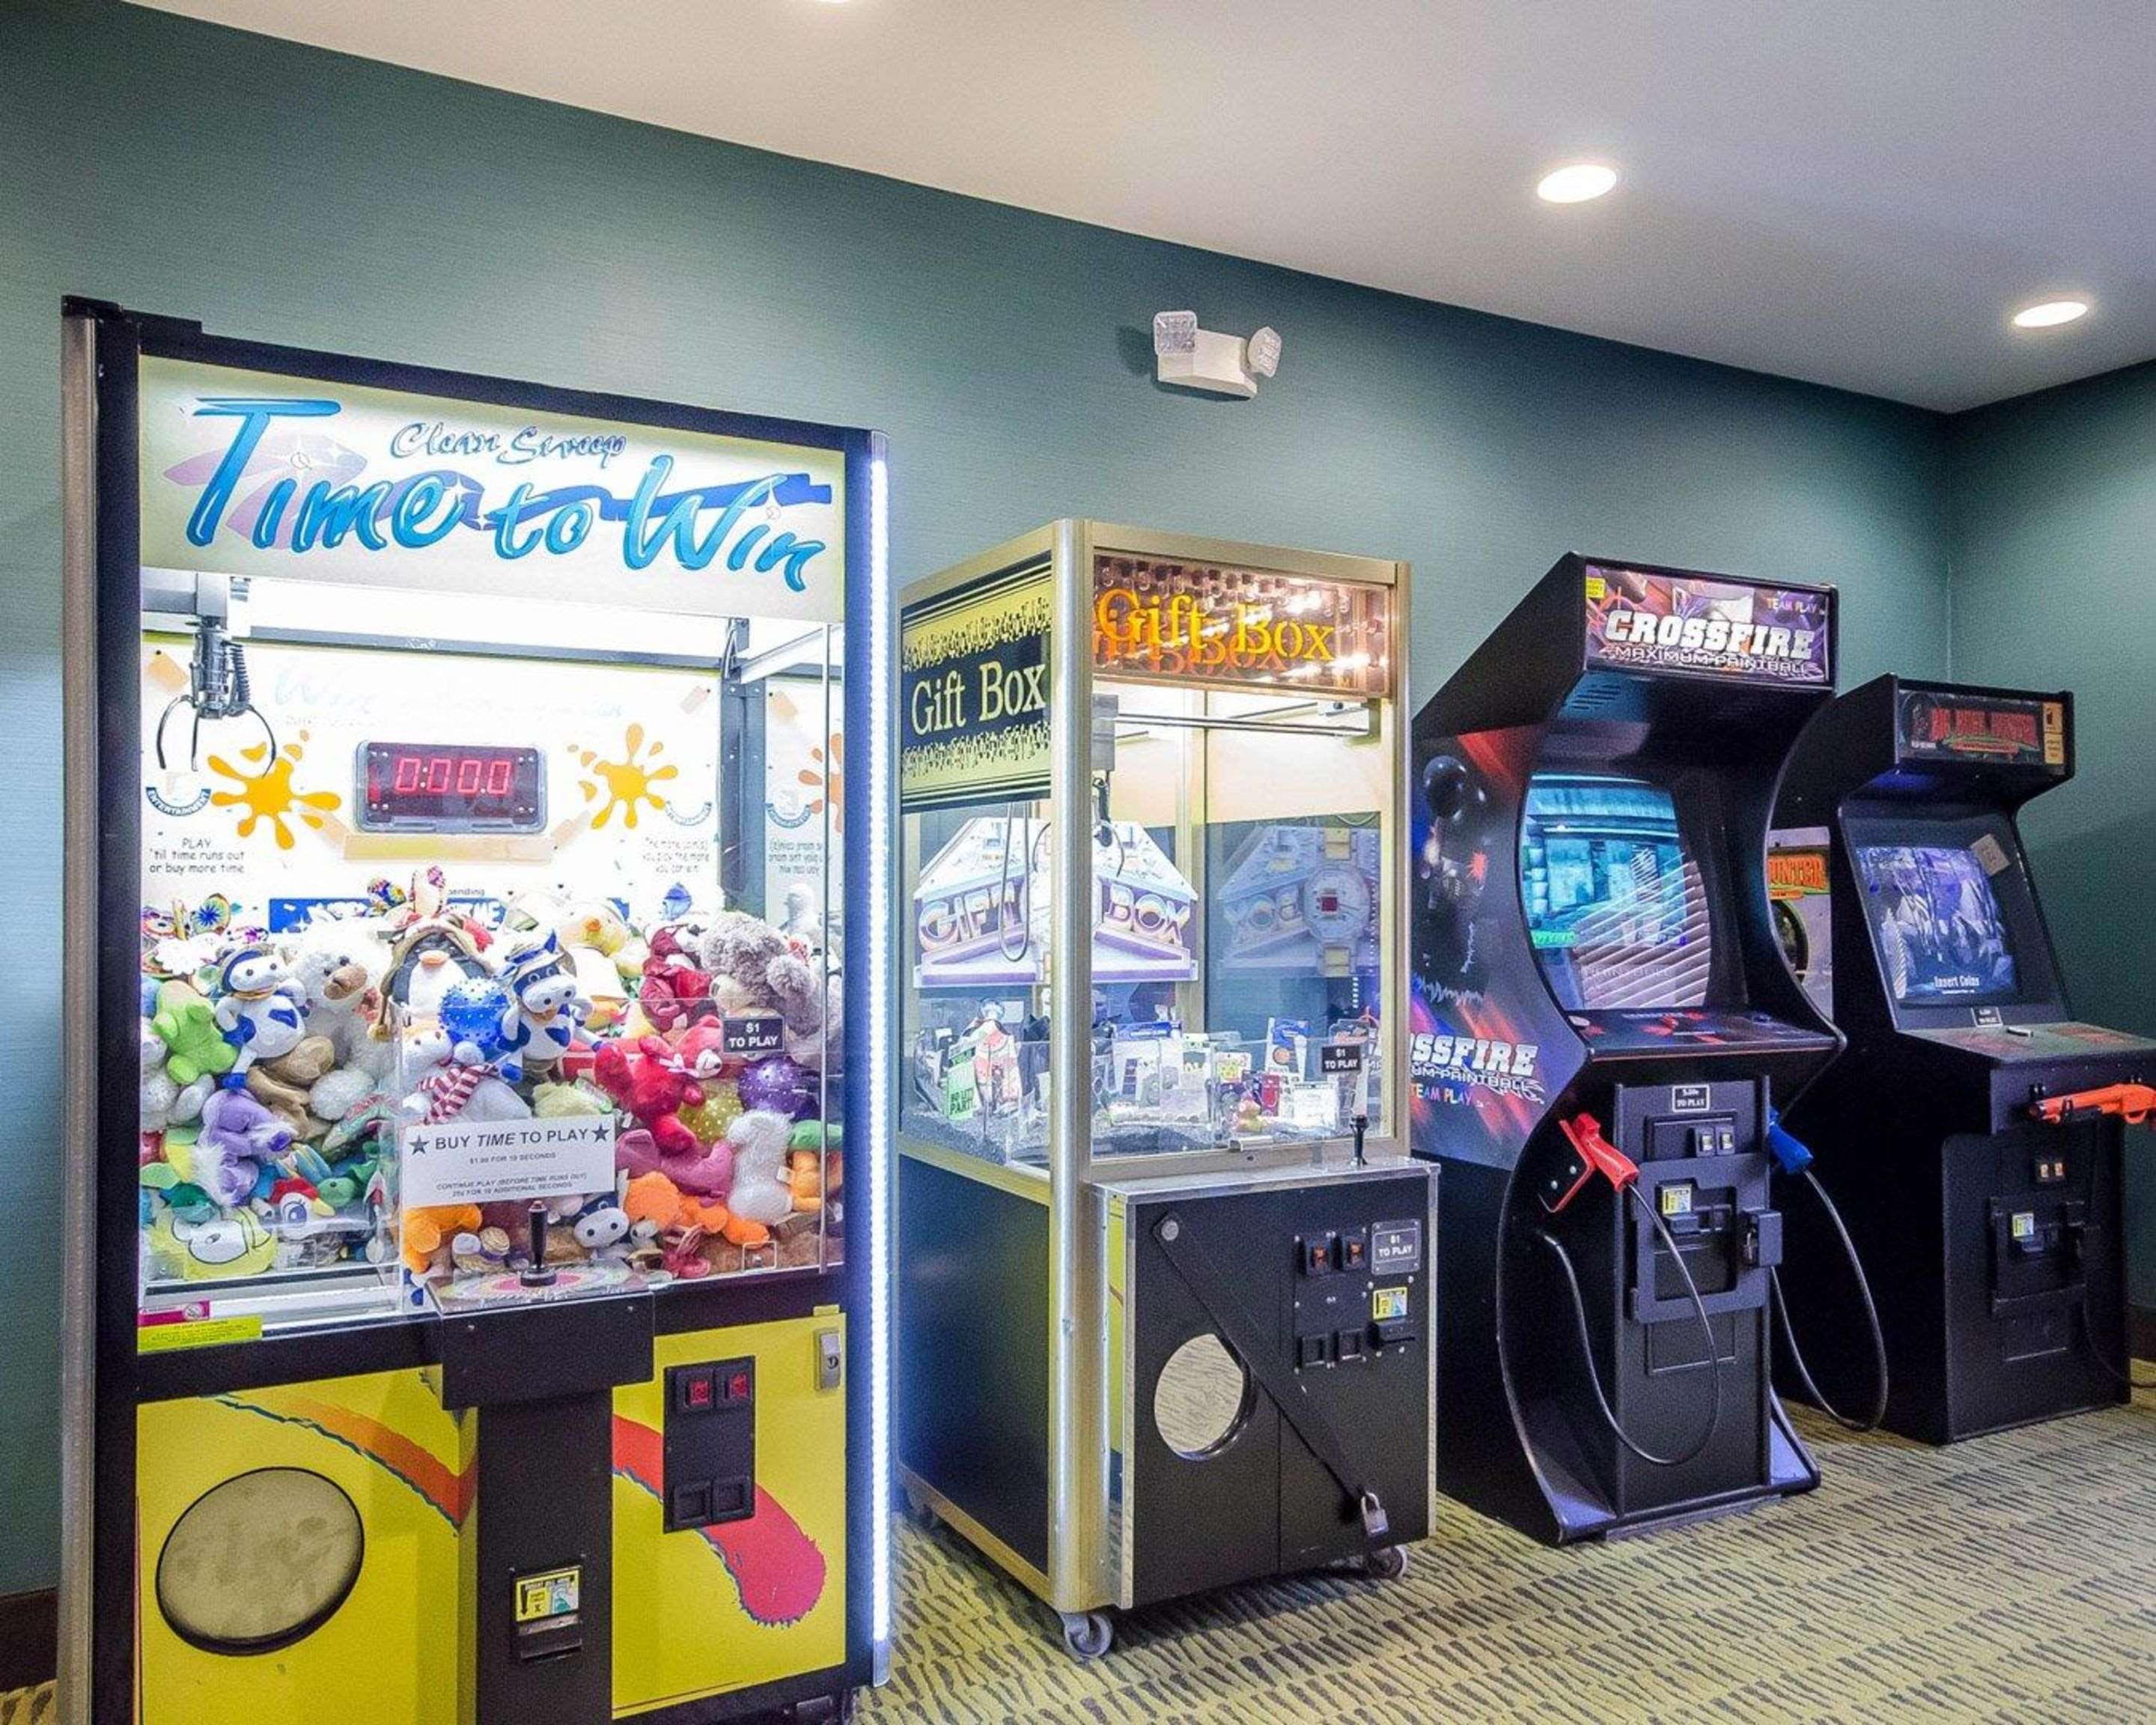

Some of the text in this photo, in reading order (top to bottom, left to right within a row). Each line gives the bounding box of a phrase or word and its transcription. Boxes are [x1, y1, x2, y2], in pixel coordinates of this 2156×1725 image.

[391, 422, 627, 469] Clean Sweep
[186, 398, 826, 594] Time to Win
[1766, 597, 1792, 612] TEAM
[1794, 600, 1818, 614] PLAY
[1099, 588, 1337, 662] Gift Box
[1605, 609, 1815, 660] CROSSFIRE
[911, 662, 1047, 736] Gift Box
[182, 838, 211, 850] PLAY
[172, 851, 196, 860] time
[200, 852, 224, 860] runs
[227, 851, 244, 860] out
[149, 862, 244, 876] or buy more time
[919, 883, 1190, 951] GIFT BOX
[1934, 974, 1980, 988] Insert Coins
[746, 1022, 761, 1033] $1
[728, 1035, 779, 1048] TO PLAY
[1410, 1032, 1539, 1077] SSFIRE
[1324, 1059, 1359, 1070] TO PLAY
[1443, 1088, 1473, 1106] PLAY
[435, 1128, 588, 1151] BUY TIME TO PLAY
[519, 1151, 556, 1161] SECONDS
[436, 1181, 475, 1191] CONTINUE
[476, 1178, 496, 1187] PLAY
[493, 1184, 537, 1194] ADDITIONAL
[538, 1181, 573, 1190] SECONDS
[1378, 1245, 1413, 1257] TO PLAY
